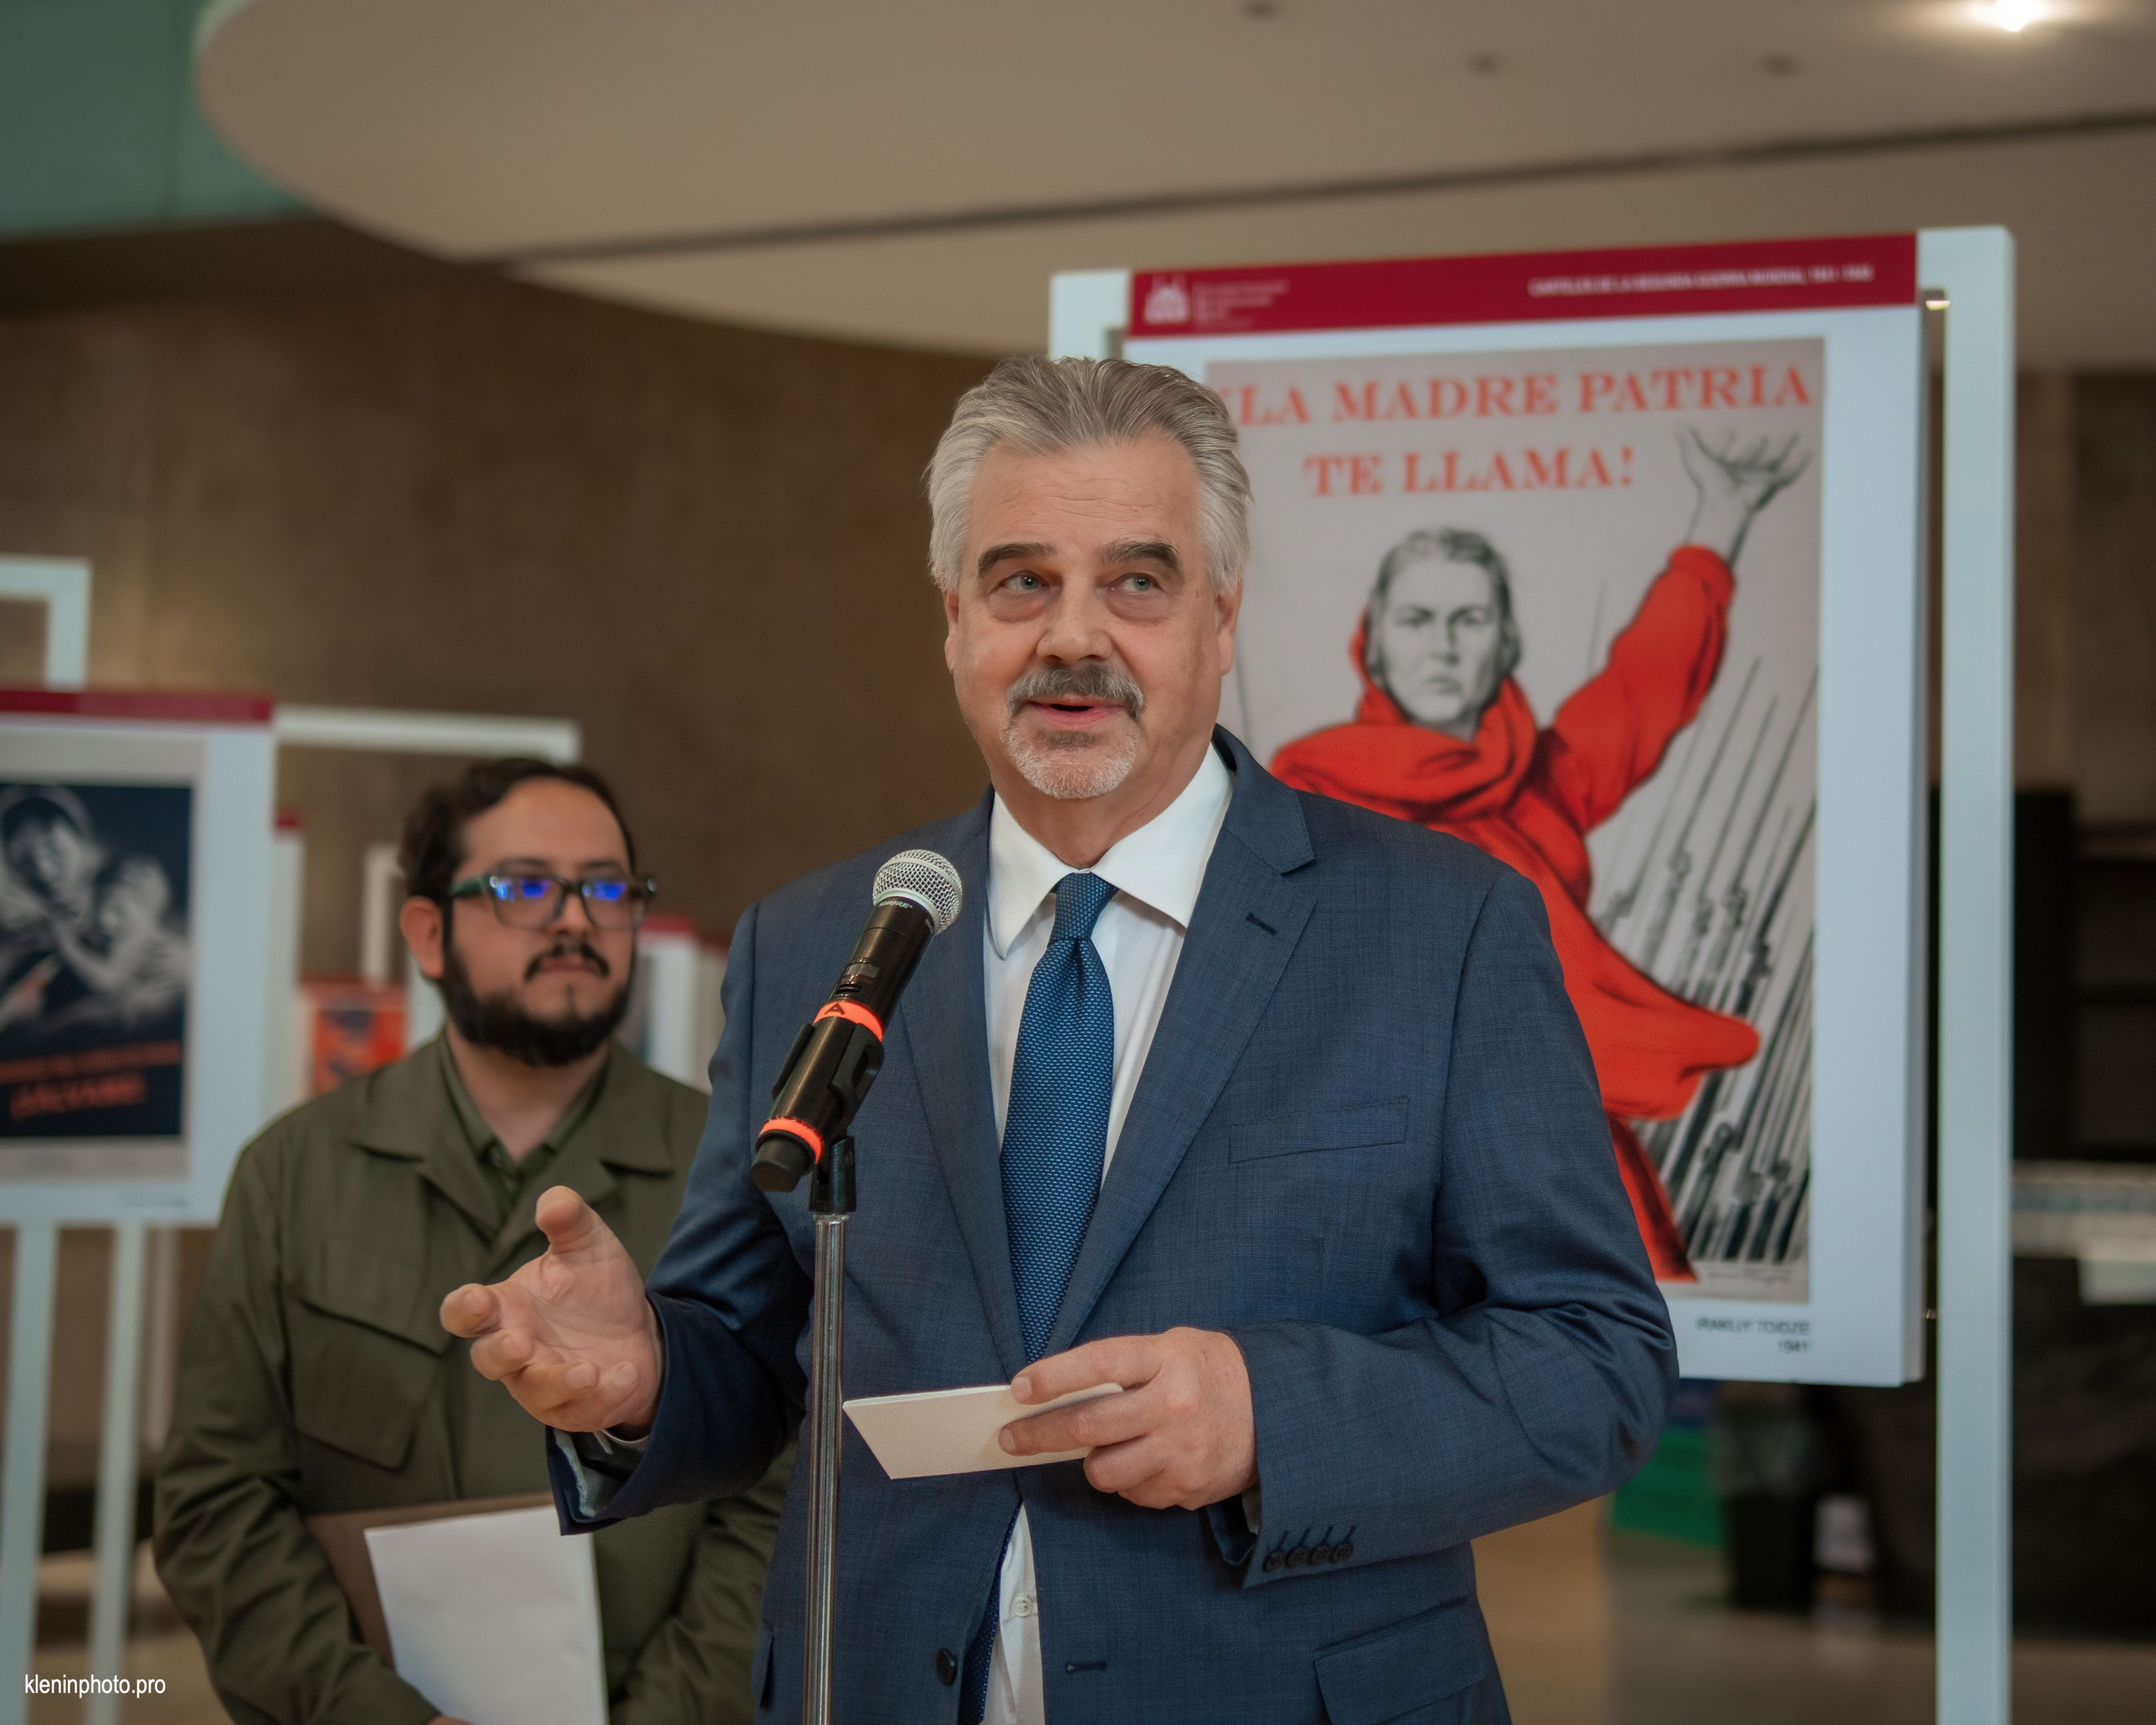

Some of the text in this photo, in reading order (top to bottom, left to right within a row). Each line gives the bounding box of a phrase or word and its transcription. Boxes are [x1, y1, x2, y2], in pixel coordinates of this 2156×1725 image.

[1219, 364, 1811, 426] LA MADRE PATRIA
[1303, 443, 1634, 497] TE LLAMA!
